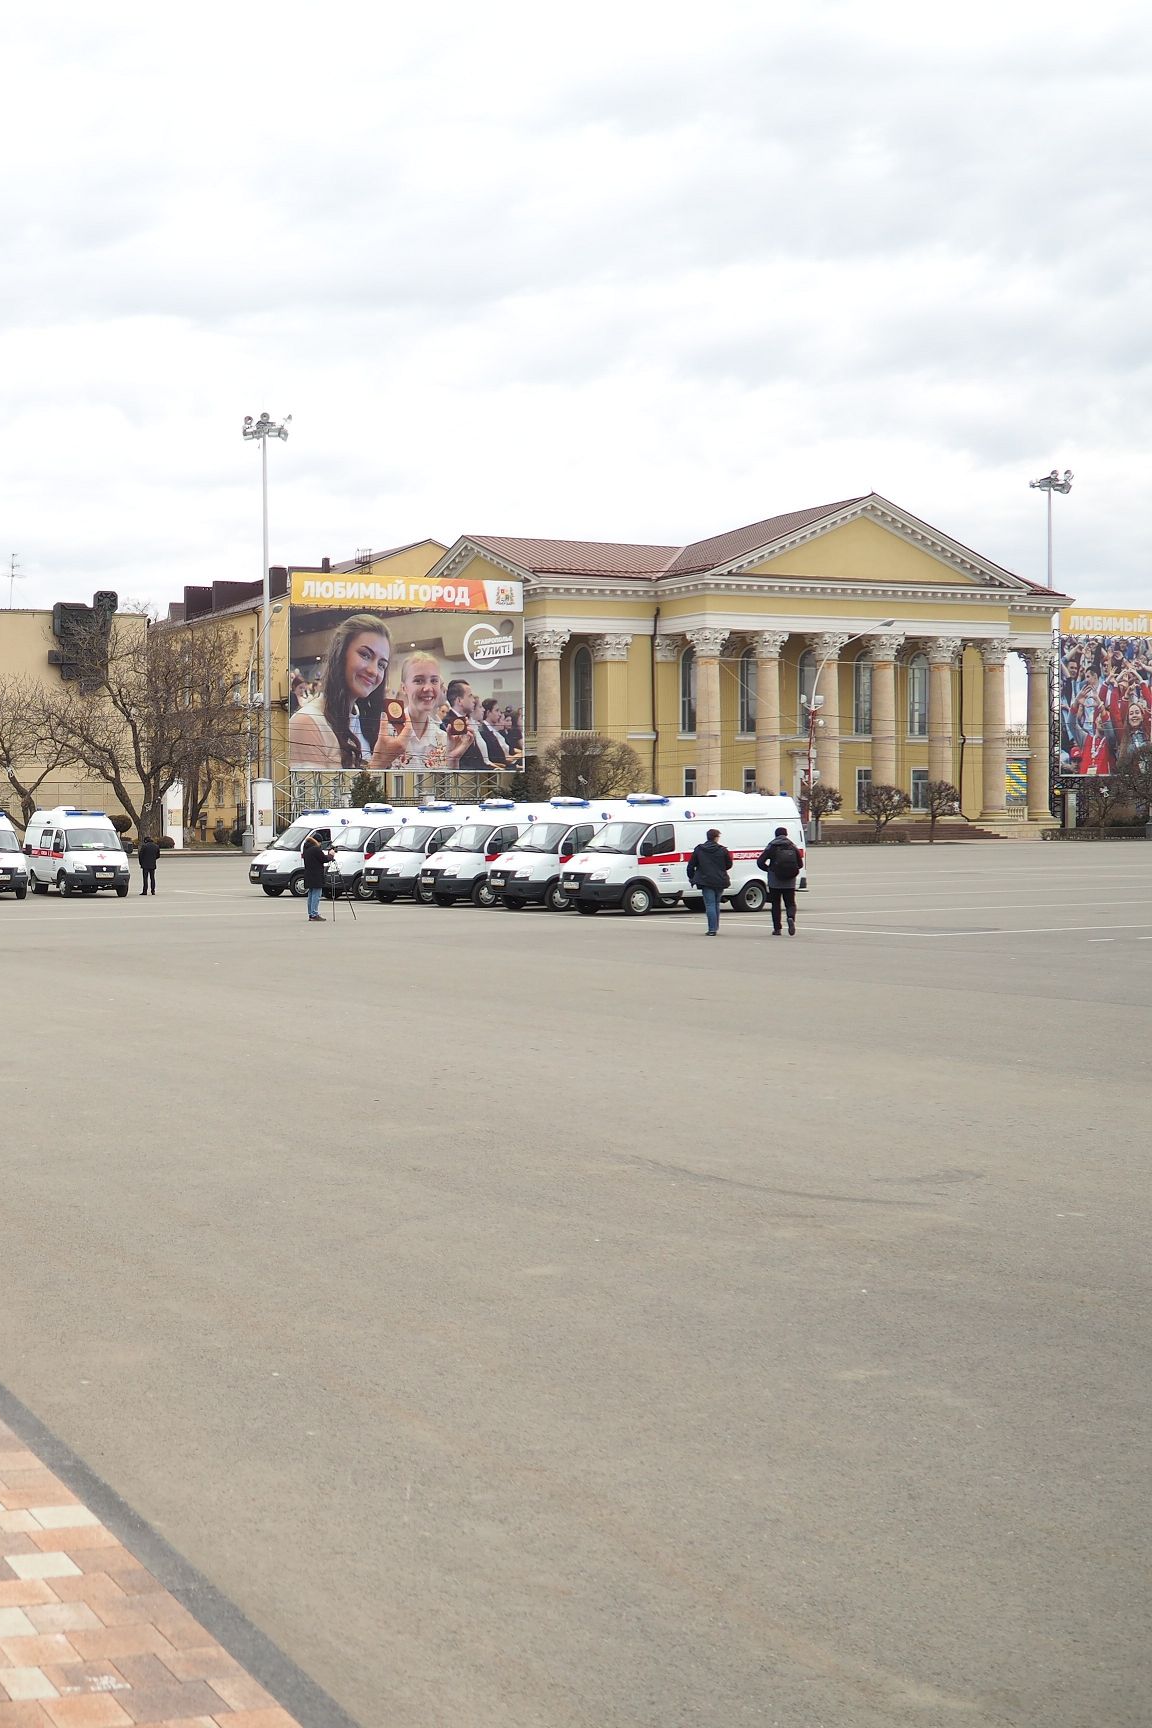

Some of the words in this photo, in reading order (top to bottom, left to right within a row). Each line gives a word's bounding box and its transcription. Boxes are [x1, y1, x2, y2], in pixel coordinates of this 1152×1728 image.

[301, 579, 406, 601] ЛЮБИМЫЙ
[409, 584, 470, 606] ГОРОД
[1069, 614, 1148, 632] ЛЮБИМЫЙ
[475, 645, 511, 658] РУЛИТ!
